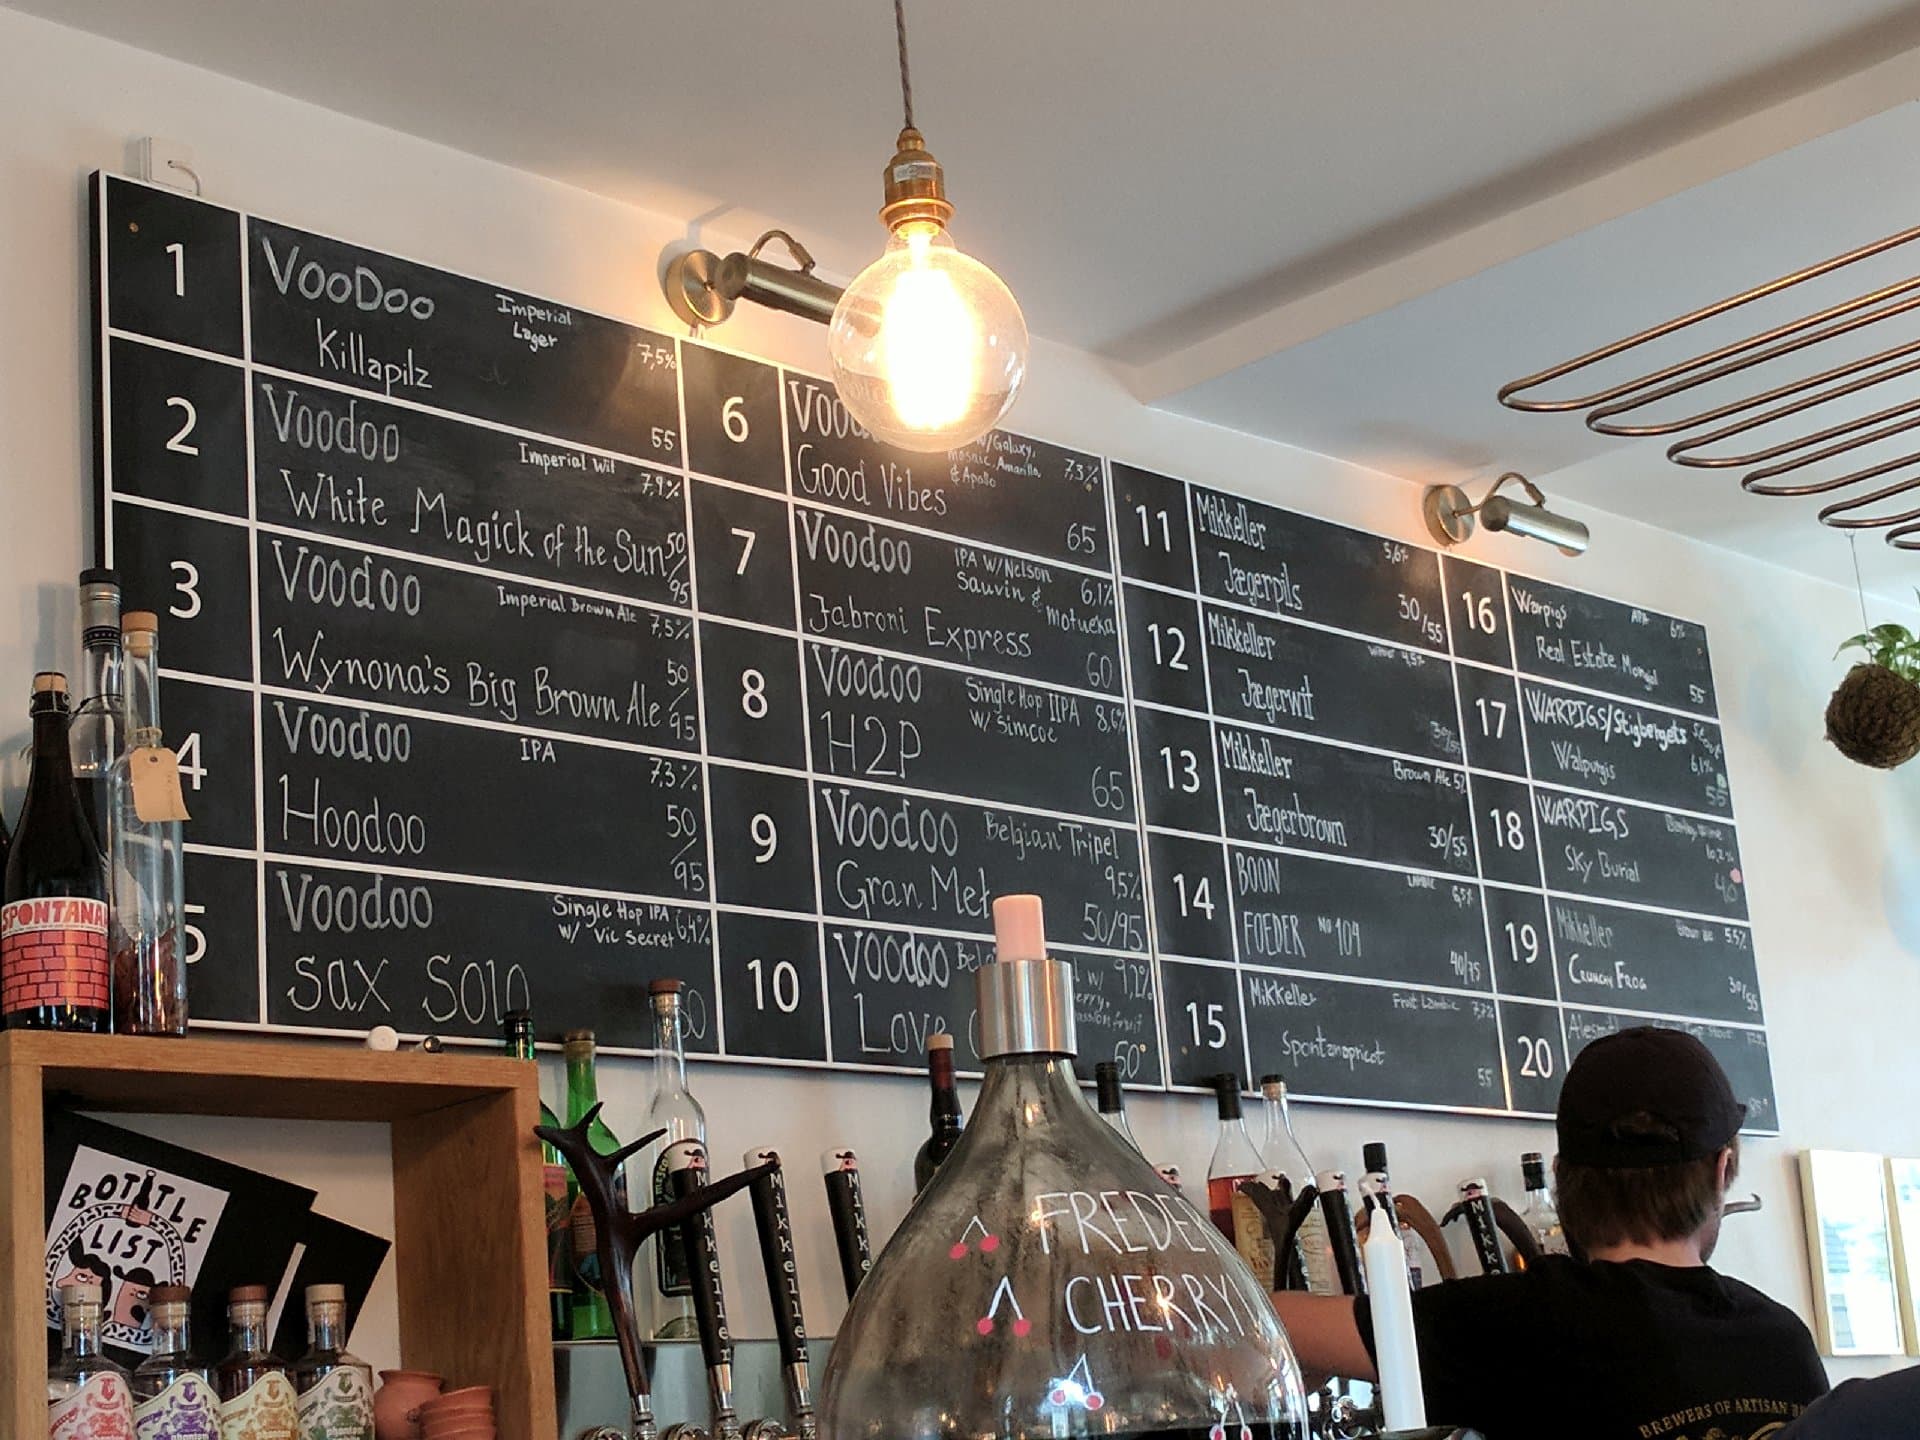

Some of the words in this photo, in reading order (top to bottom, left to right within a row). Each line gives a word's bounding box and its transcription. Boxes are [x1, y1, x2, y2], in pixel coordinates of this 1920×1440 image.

[165, 243, 184, 297] 1
[496, 293, 572, 327] Imperial
[316, 317, 433, 396] Killapilz
[513, 321, 559, 352] Lager
[166, 397, 199, 457] 2
[262, 383, 400, 463] Voodoo
[650, 427, 676, 450] 55
[722, 396, 749, 443] 6
[519, 442, 587, 475] Imperial
[798, 444, 871, 506] Good
[879, 463, 948, 516] Vibes
[280, 468, 388, 526] White
[409, 487, 535, 564] Magick
[543, 523, 565, 568] of
[574, 525, 608, 567] the
[613, 529, 667, 577] Sun
[796, 510, 912, 574] Voodoo
[1067, 522, 1096, 554] 65
[1136, 504, 1171, 553] 11
[1196, 491, 1267, 551] Mikkeller
[731, 527, 756, 576] 7
[954, 548, 978, 569] IPA
[169, 561, 202, 619] 3
[272, 540, 421, 617] Voodoo
[956, 571, 1026, 604] Sauvin
[497, 585, 567, 617] Imperial
[570, 596, 615, 618] Brown
[617, 607, 637, 624] Ale
[809, 593, 909, 633] Jabroni
[924, 606, 1033, 662] Express
[1462, 591, 1497, 635] 16
[1511, 585, 1568, 630] Warpigs
[1147, 623, 1190, 671] 12
[1207, 611, 1276, 660] Mikkeller
[1536, 635, 1566, 664] Real
[1570, 639, 1617, 669] Estate
[272, 626, 451, 695] Wynona's
[466, 662, 518, 722] Big
[535, 667, 620, 722] Brown
[626, 680, 662, 728] Ale
[811, 643, 922, 703] Voodoo
[1087, 651, 1113, 689] 60
[742, 669, 769, 720] 8
[965, 676, 1016, 714] Single
[1019, 685, 1043, 717] Hop
[1049, 692, 1081, 727] IIPA
[272, 701, 411, 764] Voodoo
[997, 716, 1059, 744] Simcoe
[1475, 698, 1507, 740] 17
[176, 732, 208, 791] 4
[520, 737, 557, 763] IPA
[1160, 746, 1201, 793] 13
[1220, 729, 1293, 779] Mikkeller
[1392, 760, 1432, 784] Brown
[1091, 766, 1125, 811] 65
[279, 774, 426, 854] Hoodoo
[821, 788, 959, 857] Voodoo
[984, 811, 1062, 862] Belgian
[1057, 821, 1120, 865] Tripel
[1490, 808, 1525, 851] 18
[1536, 794, 1629, 841] WARPIGS
[751, 813, 778, 864] 9
[1235, 852, 1282, 897] BOON
[1565, 844, 1593, 885] Sky
[1598, 848, 1641, 883] Burial
[277, 870, 434, 933] Voodoo
[551, 895, 612, 928] Single
[616, 907, 643, 926] Hop
[649, 907, 670, 922] IPA
[836, 859, 922, 920] Gran
[931, 863, 991, 920] Met
[1172, 873, 1216, 920] 14
[595, 926, 620, 944] Vic
[626, 927, 674, 948] Secret
[1243, 910, 1307, 958] FOEDER
[1504, 921, 1539, 964] 19
[832, 930, 950, 989] Voodoo
[746, 959, 800, 1013] 10
[1186, 1002, 1228, 1050] 15
[1517, 1035, 1554, 1079] 20
[68, 1172, 207, 1244] BOTTLE
[846, 1172, 871, 1272] Mikke
[90, 1223, 165, 1265] LIST
[696, 1172, 732, 1363] Mkkeller
[769, 1172, 808, 1361] Mikkeller
[1637, 1403, 1713, 1439] BREWERS
[1714, 1400, 1731, 1416] OF
[1735, 1397, 1789, 1415] ARTISAN
